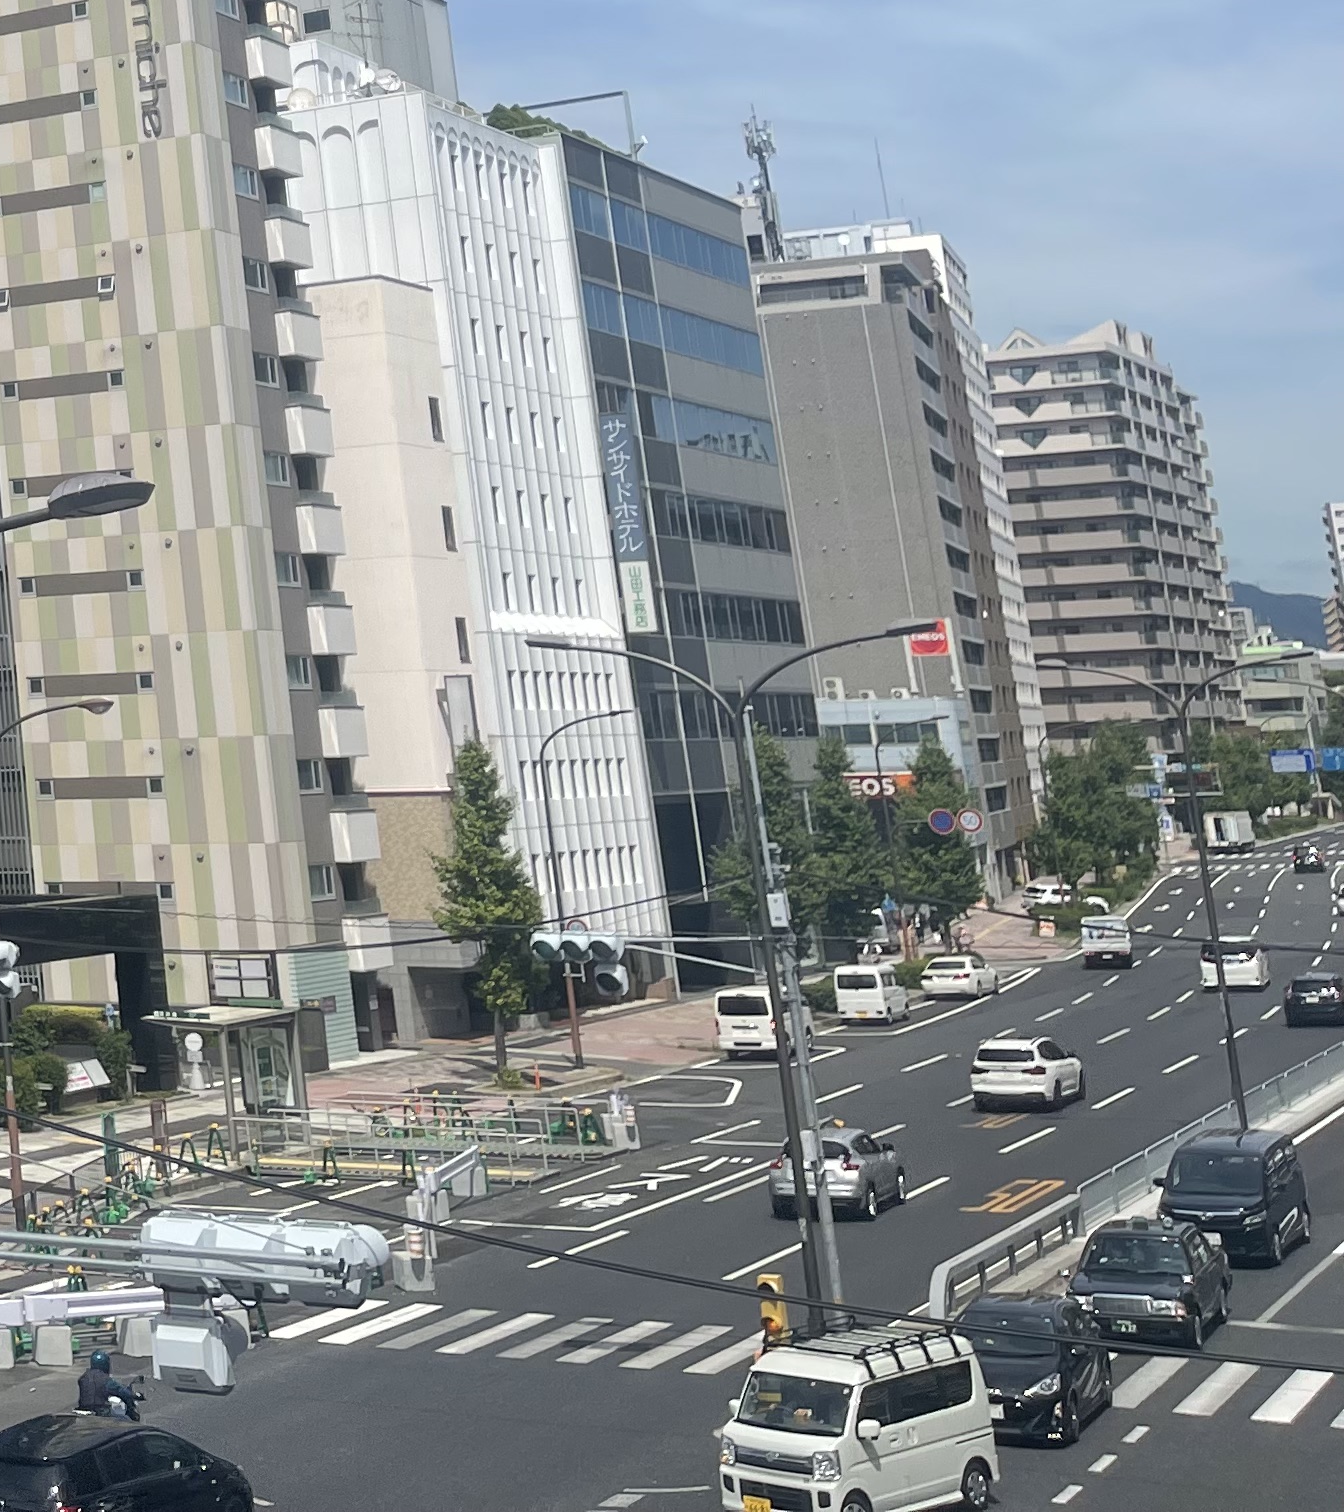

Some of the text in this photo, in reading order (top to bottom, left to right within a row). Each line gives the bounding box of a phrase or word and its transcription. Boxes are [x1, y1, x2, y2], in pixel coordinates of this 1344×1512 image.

[603, 418, 644, 553] サンサイドホテル
[849, 777, 896, 797] EOS
[959, 1179, 1066, 1213] 50
